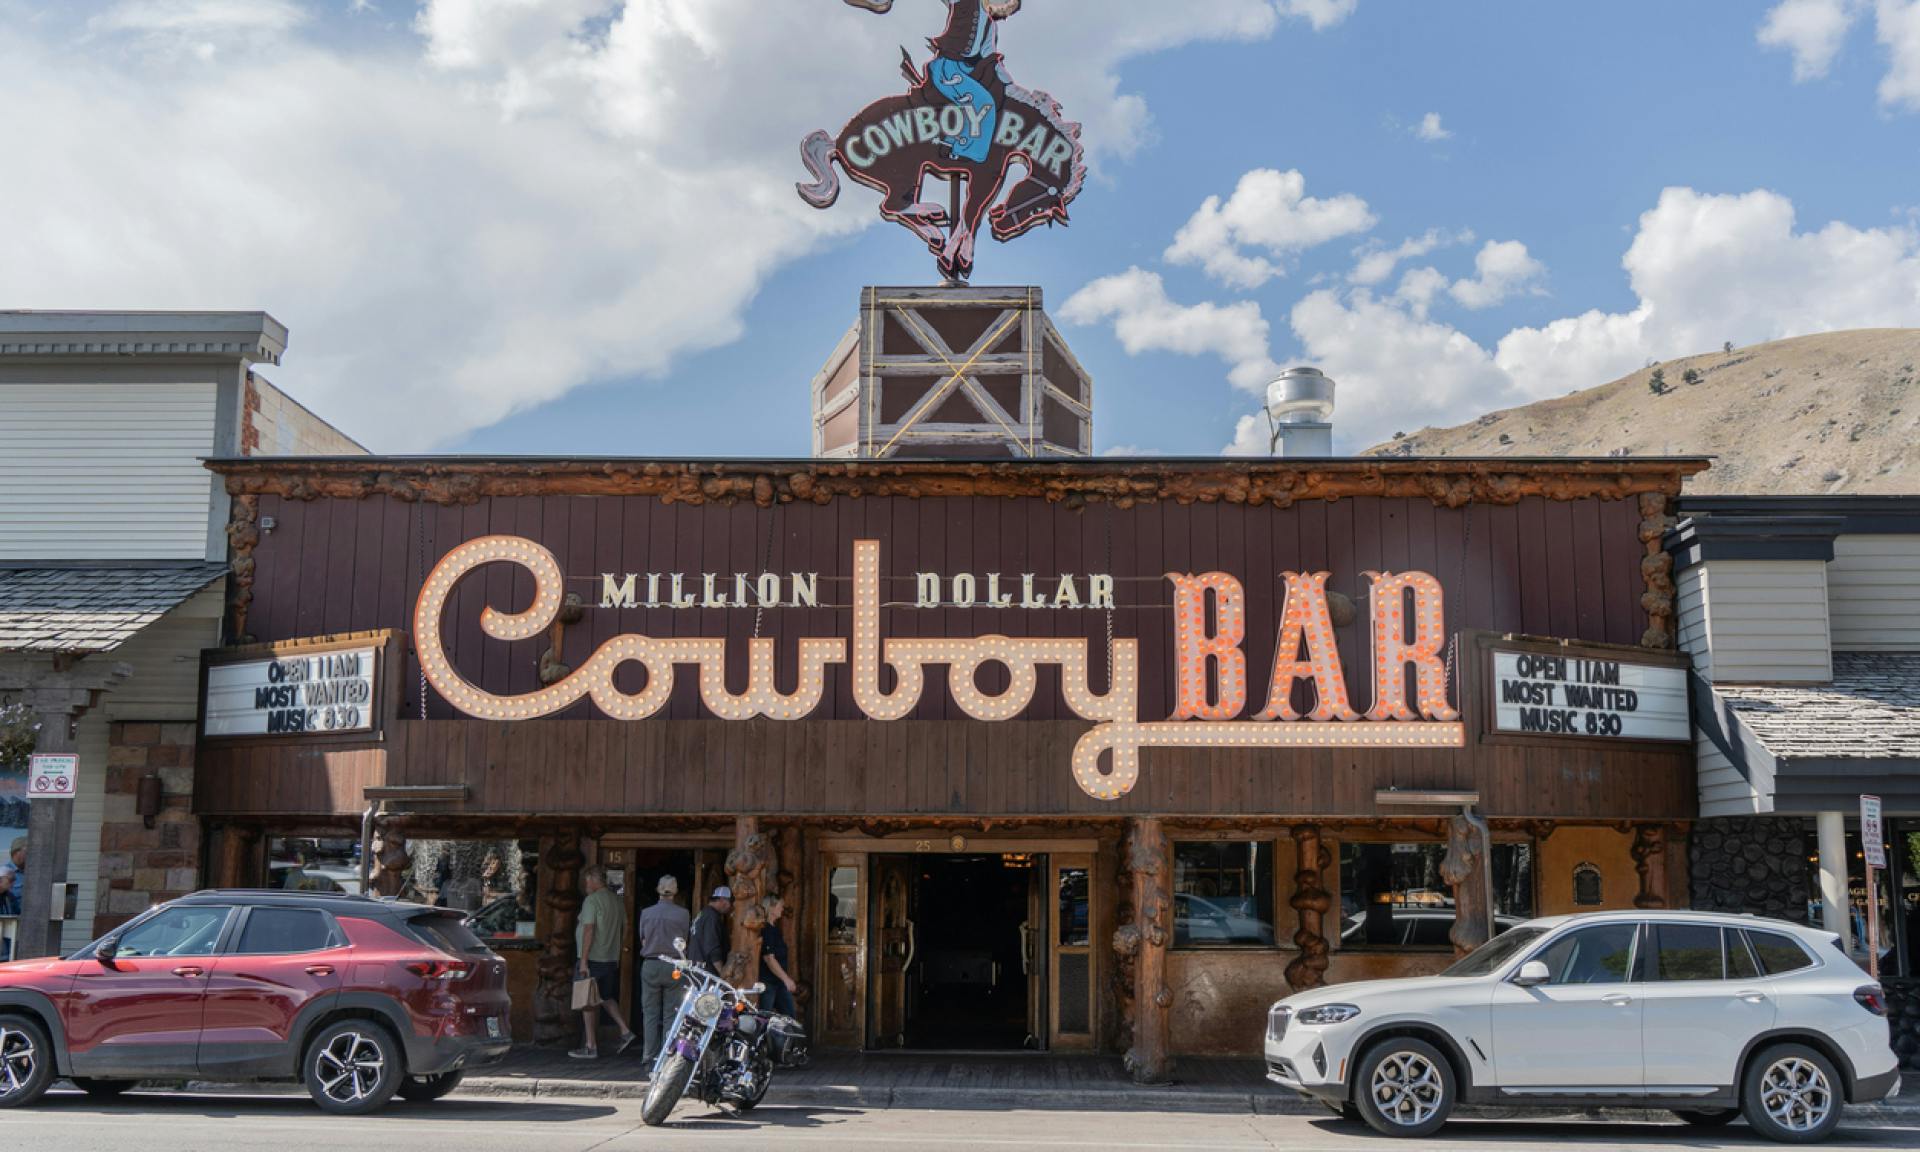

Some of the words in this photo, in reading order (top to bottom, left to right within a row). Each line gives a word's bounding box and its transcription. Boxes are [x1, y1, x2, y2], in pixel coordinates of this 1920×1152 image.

[845, 104, 993, 168] COWBOY
[996, 111, 1073, 177] BAR
[600, 572, 819, 609] MILLION
[914, 572, 1116, 610] DOLLAR
[269, 660, 309, 683] OPEN
[414, 535, 1139, 800] Cowboy
[1163, 570, 1461, 721] BAR
[1517, 654, 1567, 681] OPEN
[1576, 660, 1619, 684] 11AM
[256, 686, 297, 709] MOST
[304, 679, 369, 706] WANTED
[1502, 680, 1555, 705] MOST
[1564, 685, 1638, 712] WANTED
[268, 708, 318, 732] MUSIC
[1520, 708, 1578, 733] MUSIC
[1585, 712, 1622, 736] 830
[609, 851, 622, 863] 15
